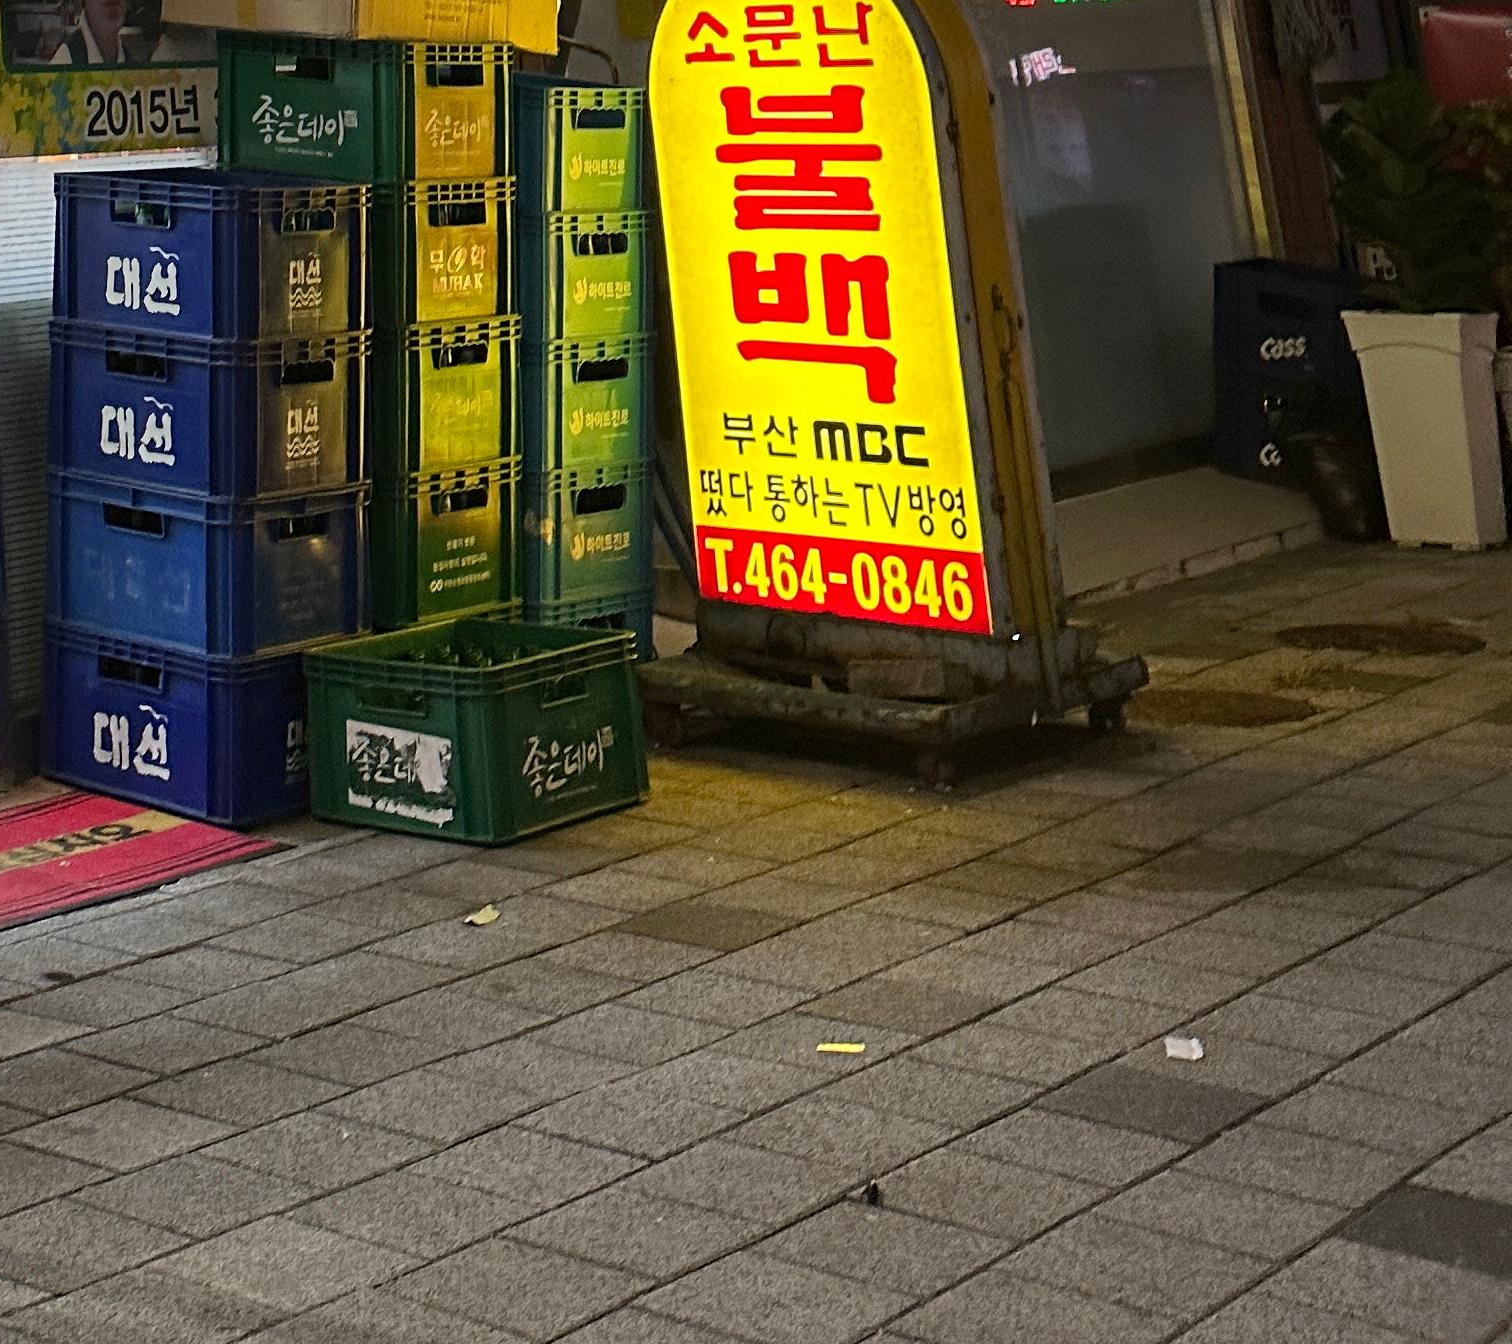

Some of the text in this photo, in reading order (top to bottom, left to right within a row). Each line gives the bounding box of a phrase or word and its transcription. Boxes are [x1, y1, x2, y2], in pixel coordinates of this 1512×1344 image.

[685, 1, 876, 70] 소문난
[86, 84, 201, 137] 2015년
[251, 94, 345, 147] 좋은데이
[424, 108, 482, 149] 좋은데이
[584, 154, 626, 177] 하이트진로
[715, 83, 900, 406] 불백
[104, 246, 182, 317] 대선
[289, 257, 322, 285] 대선
[431, 272, 485, 294] MUHAK
[588, 280, 633, 301] 하이트진로
[1259, 336, 1308, 362] Cass
[98, 398, 176, 468] 대선
[287, 404, 320, 435] 대선
[584, 407, 630, 429] 하이트진로
[722, 411, 800, 459] 부산
[699, 467, 754, 521] 떴다
[584, 530, 631, 554] 하이트진로
[703, 537, 976, 624] T.464-0846
[92, 709, 172, 782] 대선
[351, 734, 420, 785] 좋은데
[522, 728, 604, 799] 좋은데이
